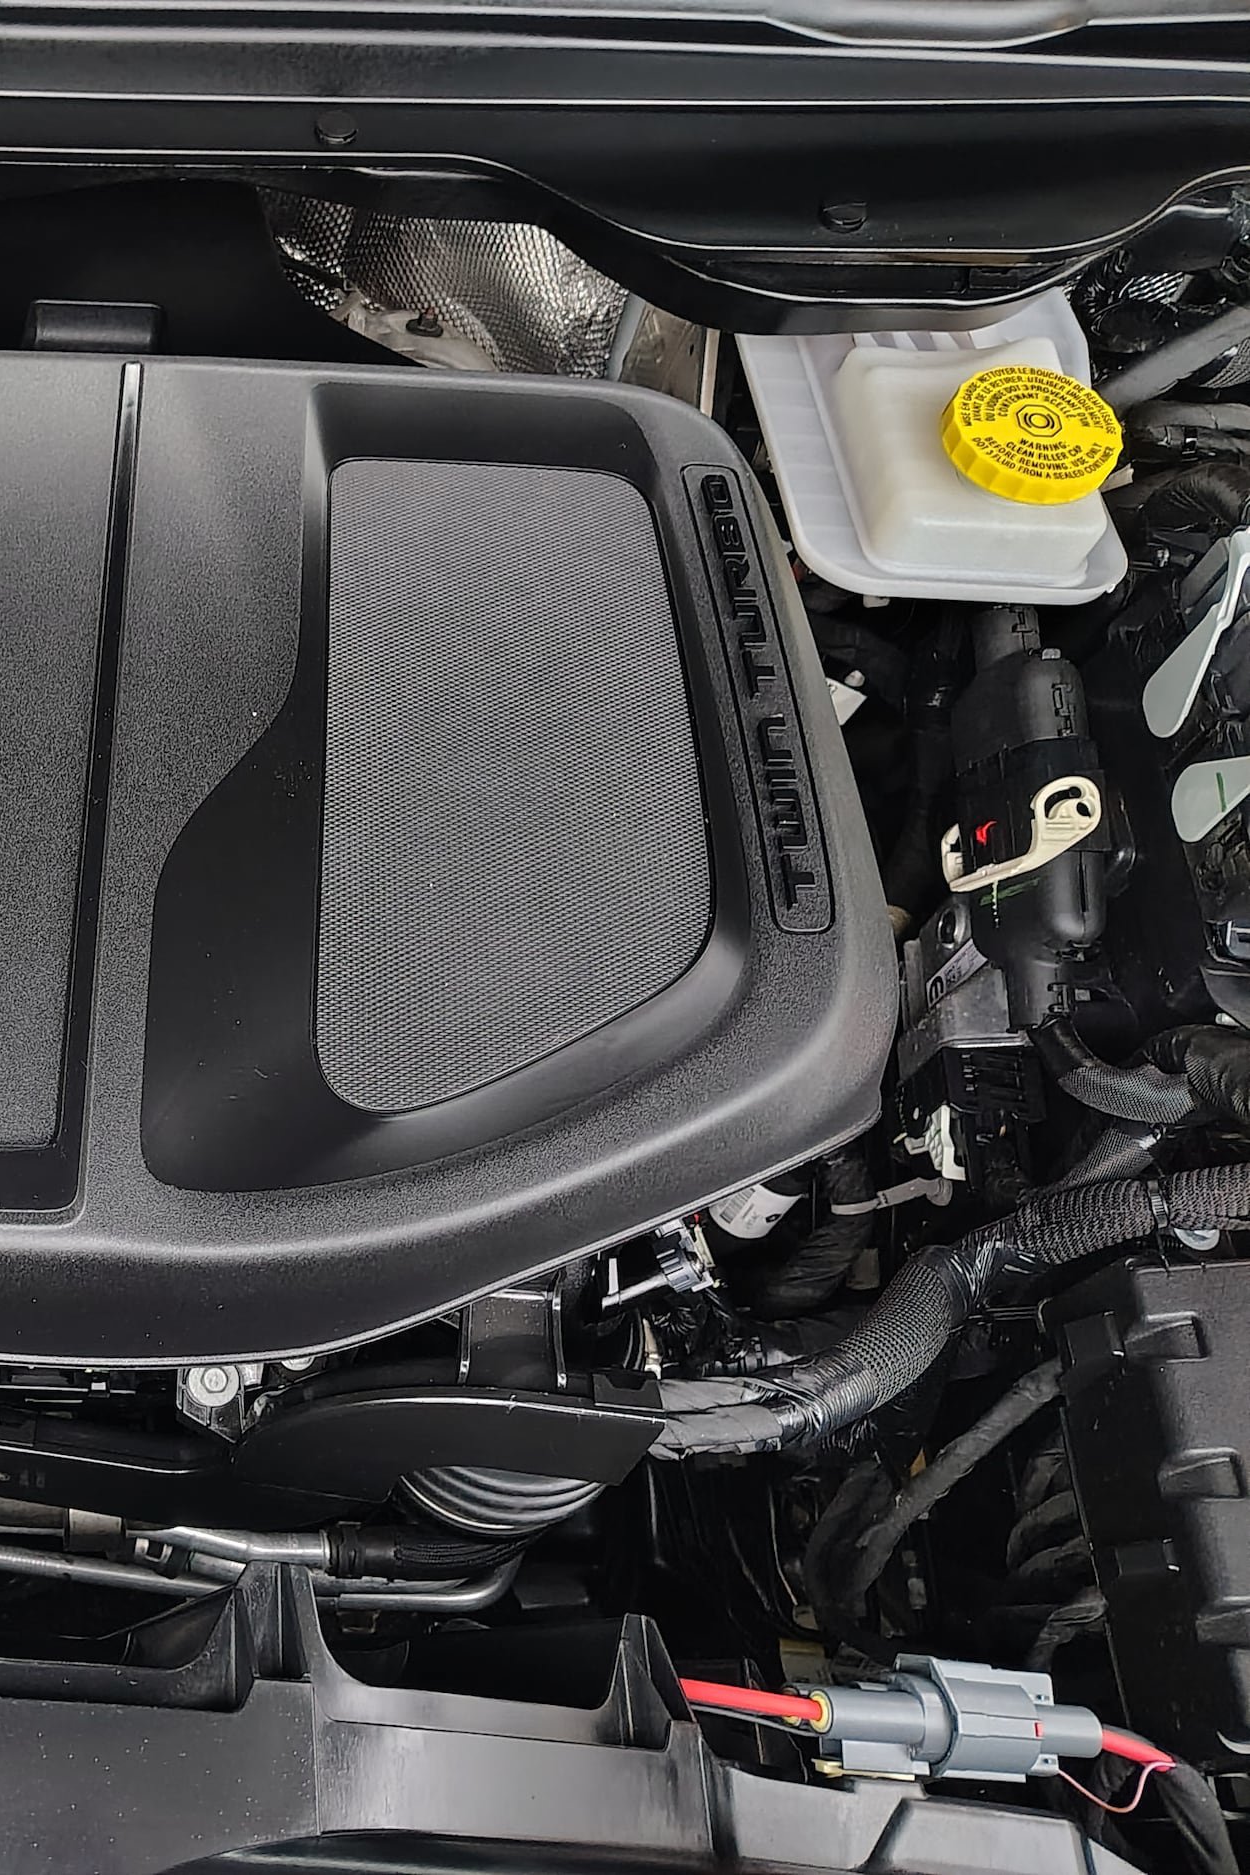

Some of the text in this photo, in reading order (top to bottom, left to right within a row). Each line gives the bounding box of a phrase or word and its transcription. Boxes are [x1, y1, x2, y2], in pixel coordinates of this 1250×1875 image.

[977, 367, 1016, 383] NETTOYER
[1030, 367, 1073, 386] BOUCHON
[1073, 383, 1086, 394] DE
[997, 393, 1039, 417] CONTENANT
[1004, 385, 1021, 394] DOT
[1031, 384, 1082, 411] PROVENANT
[1028, 377, 1066, 391] UTILISER
[1066, 389, 1104, 429] UNIQUEMENT
[972, 437, 989, 450] DOT
[991, 454, 1016, 469] FLUID
[1018, 465, 1042, 477] FROM
[1053, 469, 1085, 480] SEALED
[984, 436, 1017, 460] BEFORE
[1071, 456, 1088, 468] USE
[1086, 442, 1102, 459] ONLY
[1006, 441, 1082, 461] CLEAN FILLER CAP
[701, 474, 816, 911] TWIN TURBO
